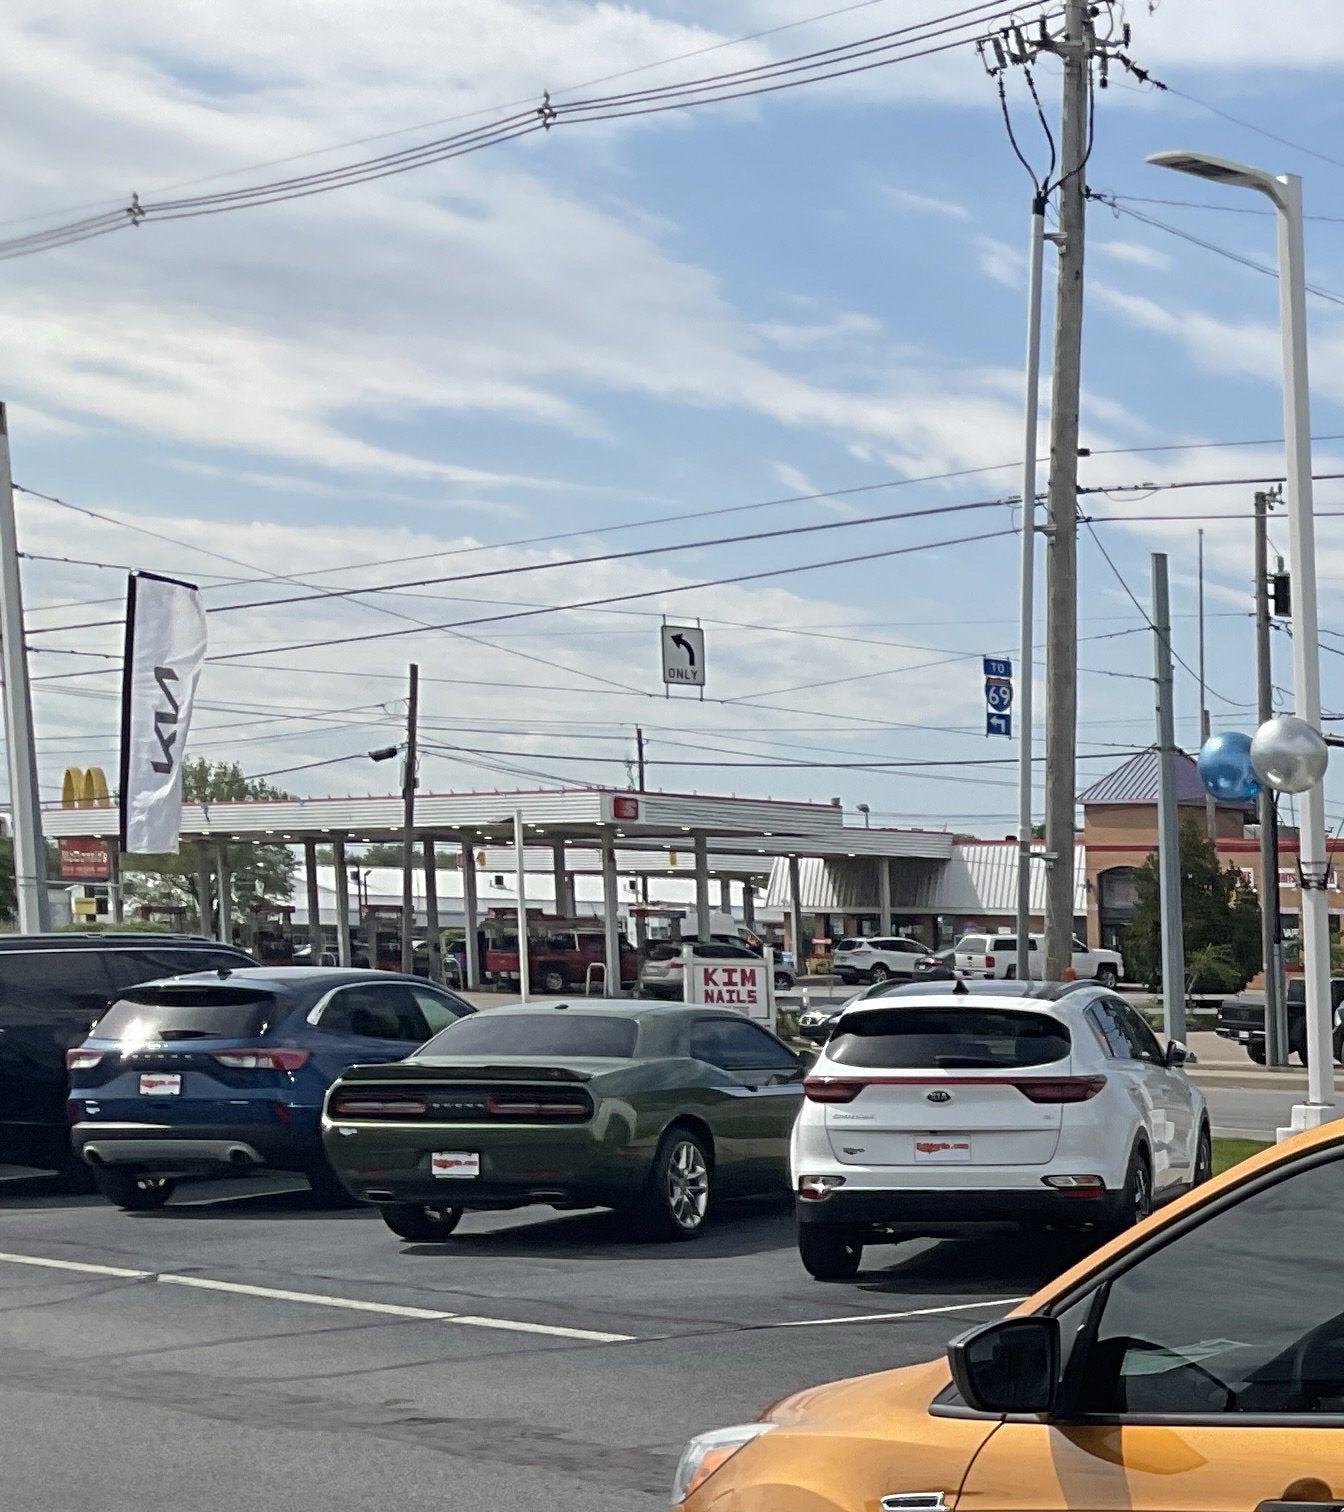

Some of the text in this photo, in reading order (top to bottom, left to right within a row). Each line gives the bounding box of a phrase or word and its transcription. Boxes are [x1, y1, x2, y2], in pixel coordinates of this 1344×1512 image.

[668, 667, 698, 680] ONLY
[990, 662, 1005, 674] TO
[988, 686, 1010, 706] 69
[703, 967, 757, 987] KIM
[704, 989, 758, 1004] NAILS
